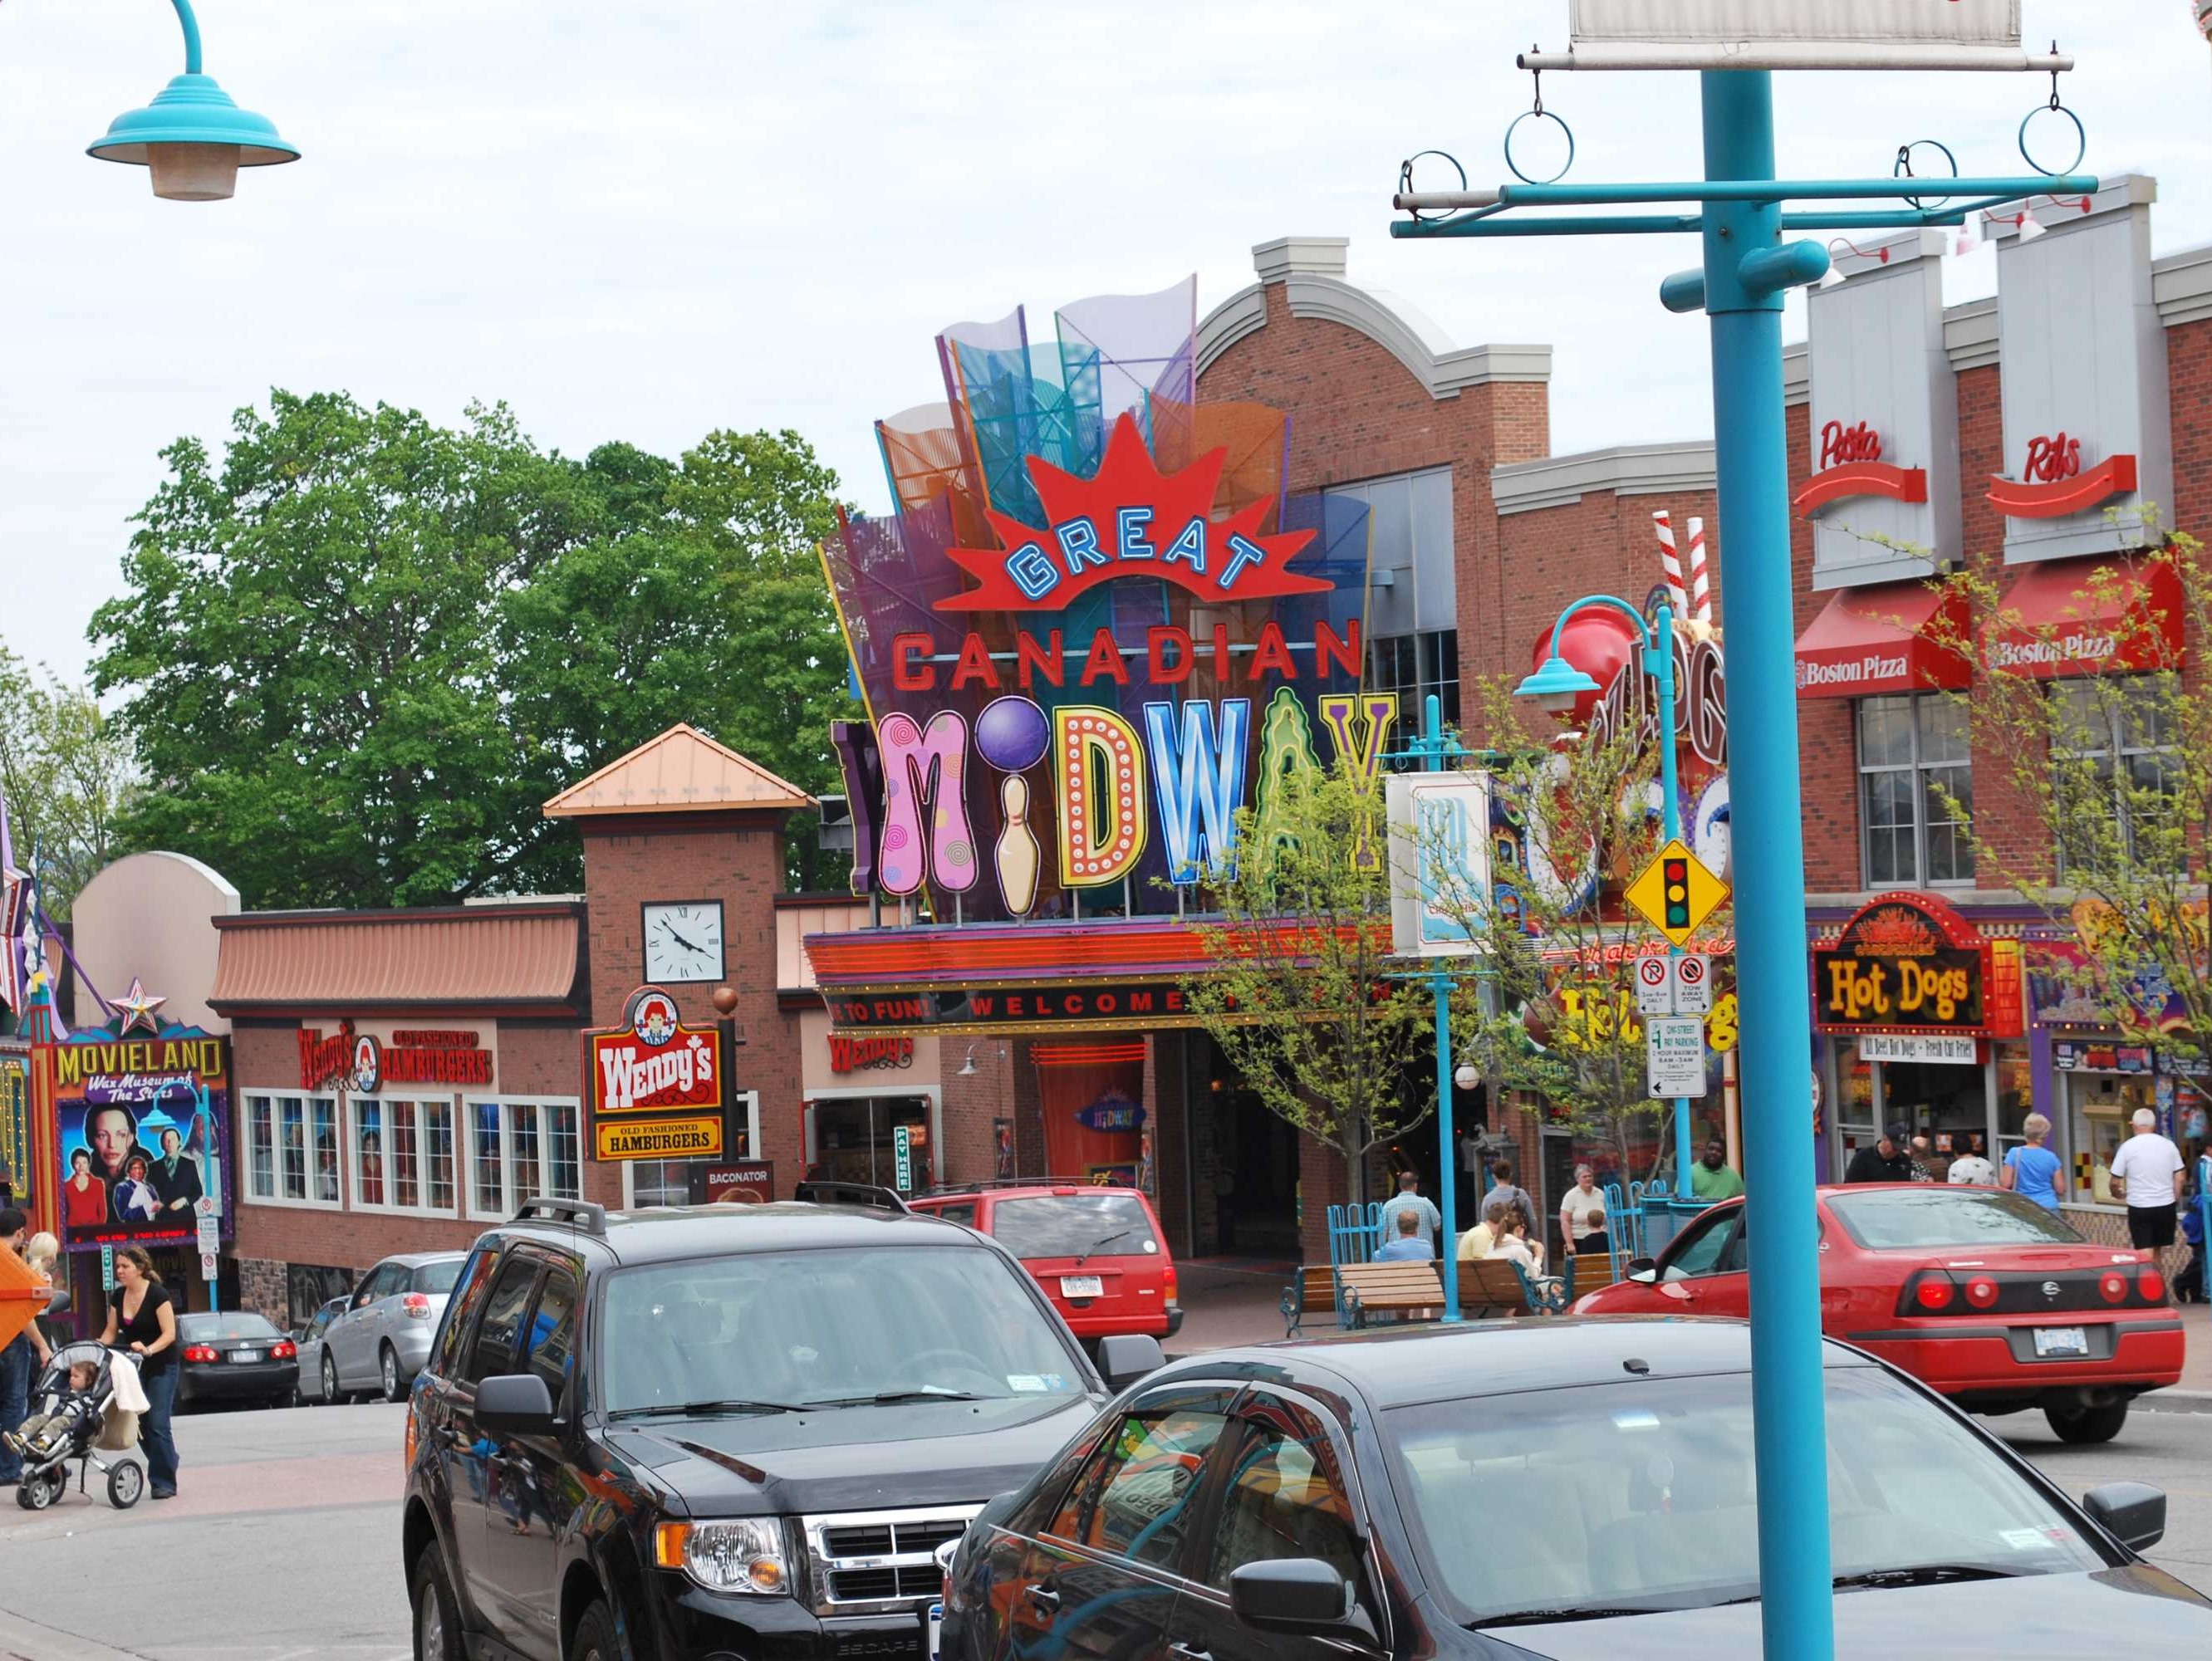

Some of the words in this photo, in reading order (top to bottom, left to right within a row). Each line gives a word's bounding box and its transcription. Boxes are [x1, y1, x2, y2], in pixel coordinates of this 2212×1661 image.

[1820, 420, 1882, 469] Pasta
[2024, 432, 2080, 483] Ribs
[1004, 505, 1265, 600] GREAT
[892, 619, 1363, 691] CANADIAN
[1999, 638, 2062, 664] Boston
[2066, 635, 2116, 659] Pizza
[1806, 659, 1861, 685] Boston
[1863, 656, 1908, 679] Pizza
[969, 990, 1184, 1017] WELCOME
[1828, 961, 1889, 1017] Hot
[1898, 960, 1968, 1020] Dogs
[844, 1002, 869, 1022] TO
[874, 998, 931, 1021] FUN!
[56, 1040, 221, 1085] MOVIELAND
[297, 1022, 352, 1090] Wendy's
[381, 1049, 488, 1084] HAMBURGERS
[88, 1075, 116, 1090] Wax
[118, 1073, 171, 1090] Museum
[177, 1070, 194, 1090] of
[600, 1035, 712, 1109] Wendy's
[108, 1090, 132, 1103] The
[610, 1132, 710, 1152] HAMBURGERS
[644, 1124, 698, 1133] FASHIONED
[897, 1130, 906, 1153] PAY
[709, 1171, 768, 1184] BACONATOR
[899, 1156, 908, 1186] HERE
